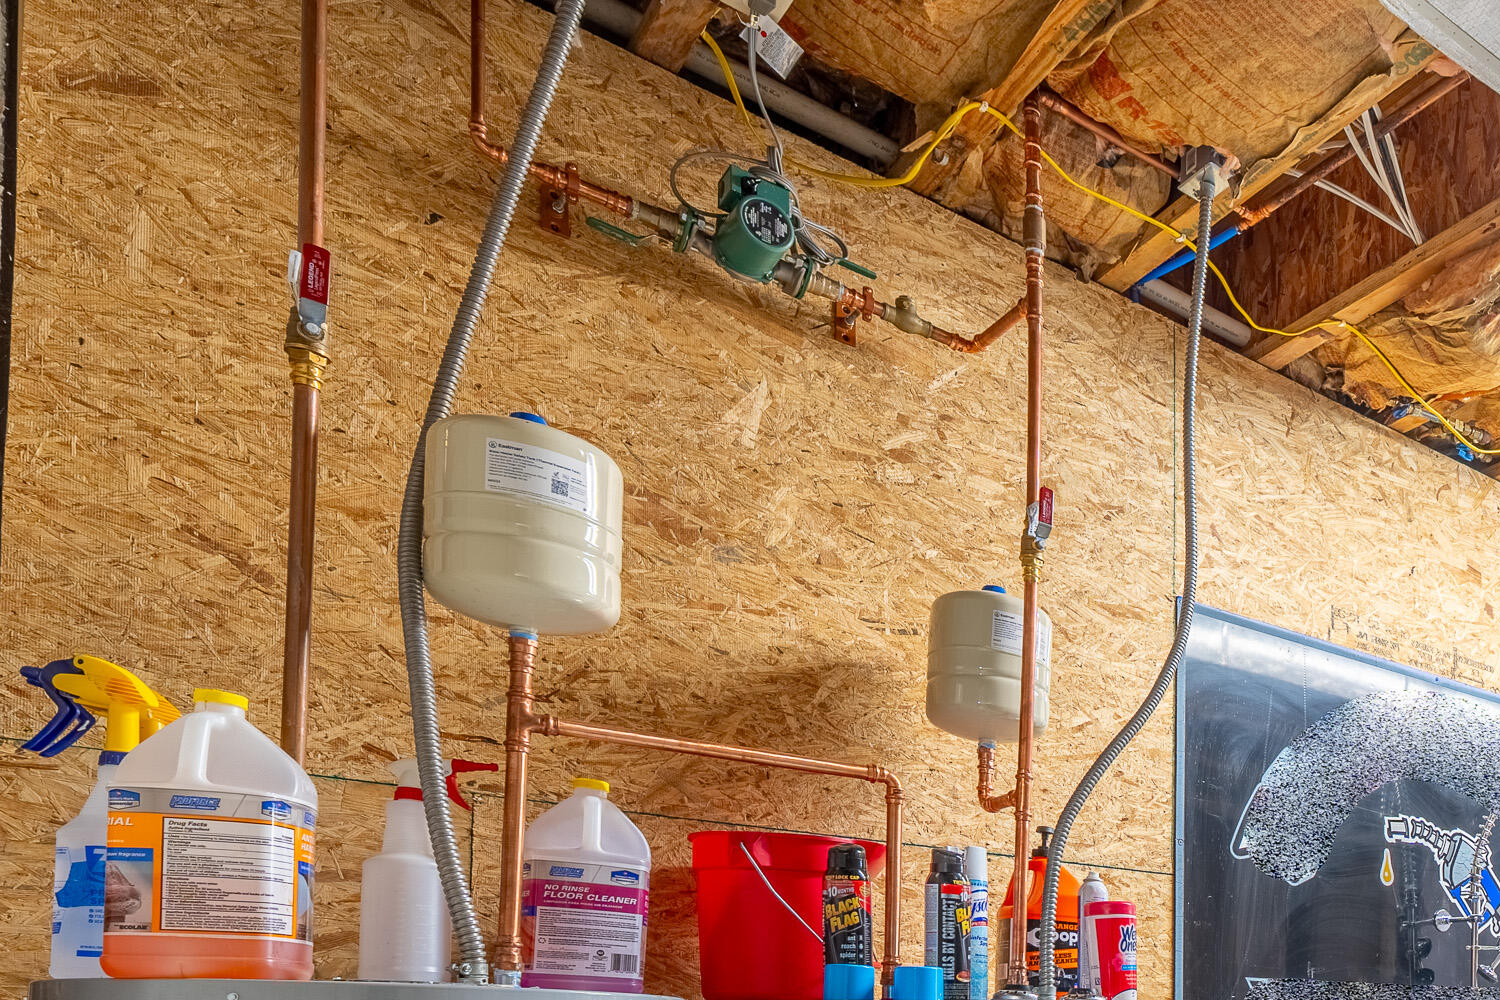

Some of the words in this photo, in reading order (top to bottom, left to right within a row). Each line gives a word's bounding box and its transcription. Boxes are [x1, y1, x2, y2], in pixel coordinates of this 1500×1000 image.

[543, 892, 583, 900] FLOOR
[586, 894, 637, 905] CLEANER
[828, 886, 837, 897] 10
[826, 896, 860, 918] BLACK
[830, 911, 860, 933] FLAG
[942, 899, 956, 939] CONTACT
[942, 942, 955, 953] BY
[943, 956, 955, 980] KILLS
